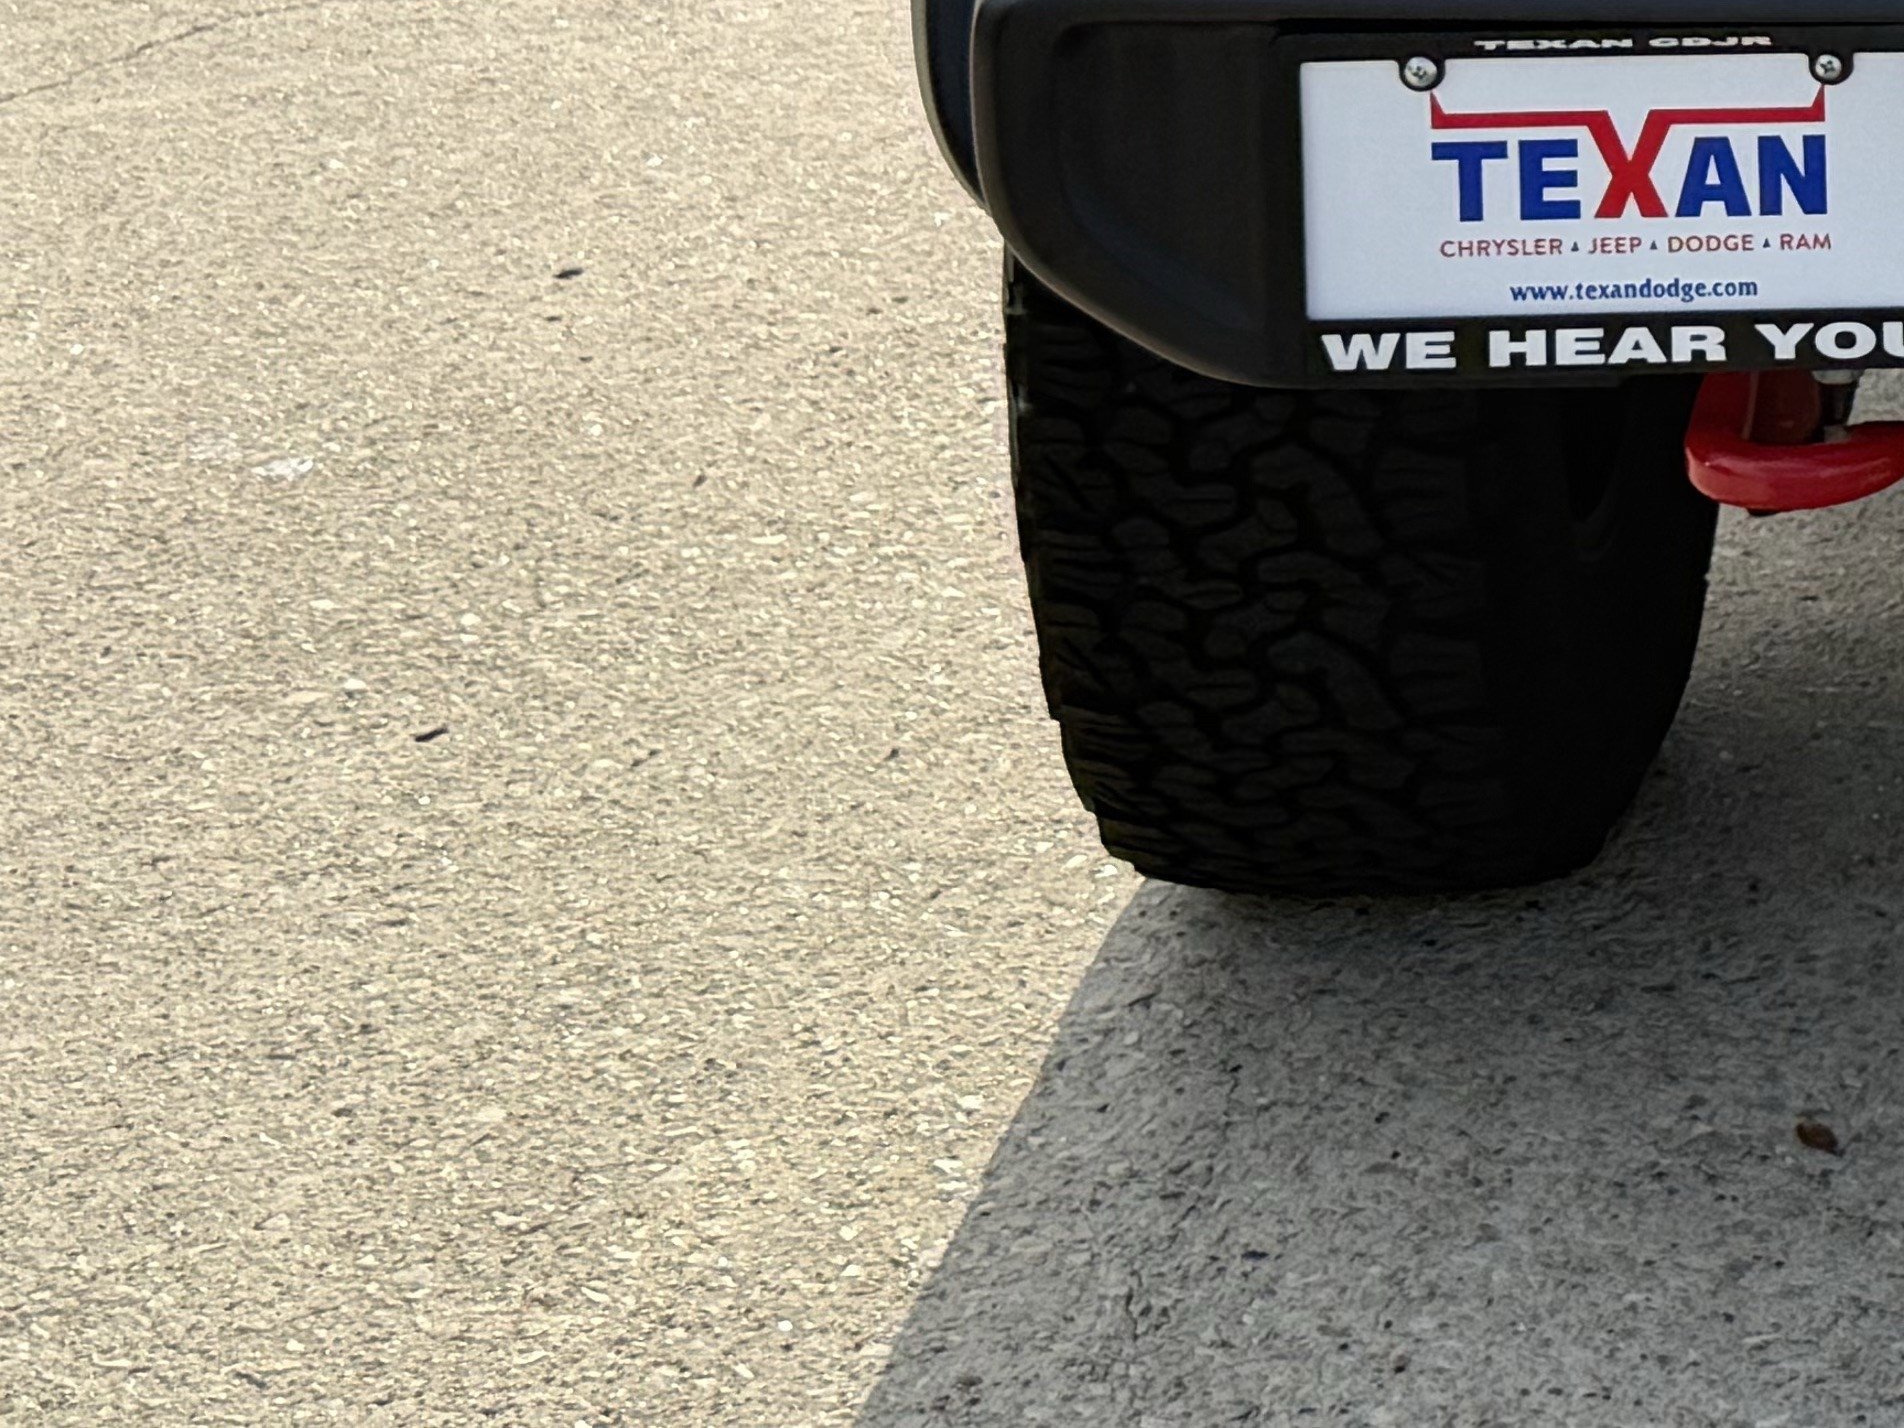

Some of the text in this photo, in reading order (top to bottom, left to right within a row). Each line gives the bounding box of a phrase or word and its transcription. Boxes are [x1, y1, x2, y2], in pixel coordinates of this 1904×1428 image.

[1473, 40, 1633, 51] TEXAN
[1430, 110, 1829, 222] TEXAN
[1440, 233, 1833, 258] CHRYSLER JEEP DODGE RAM
[1509, 278, 1759, 303] www.texandodge.com
[1320, 331, 1457, 372] WE
[1488, 325, 1727, 367] HEAR
